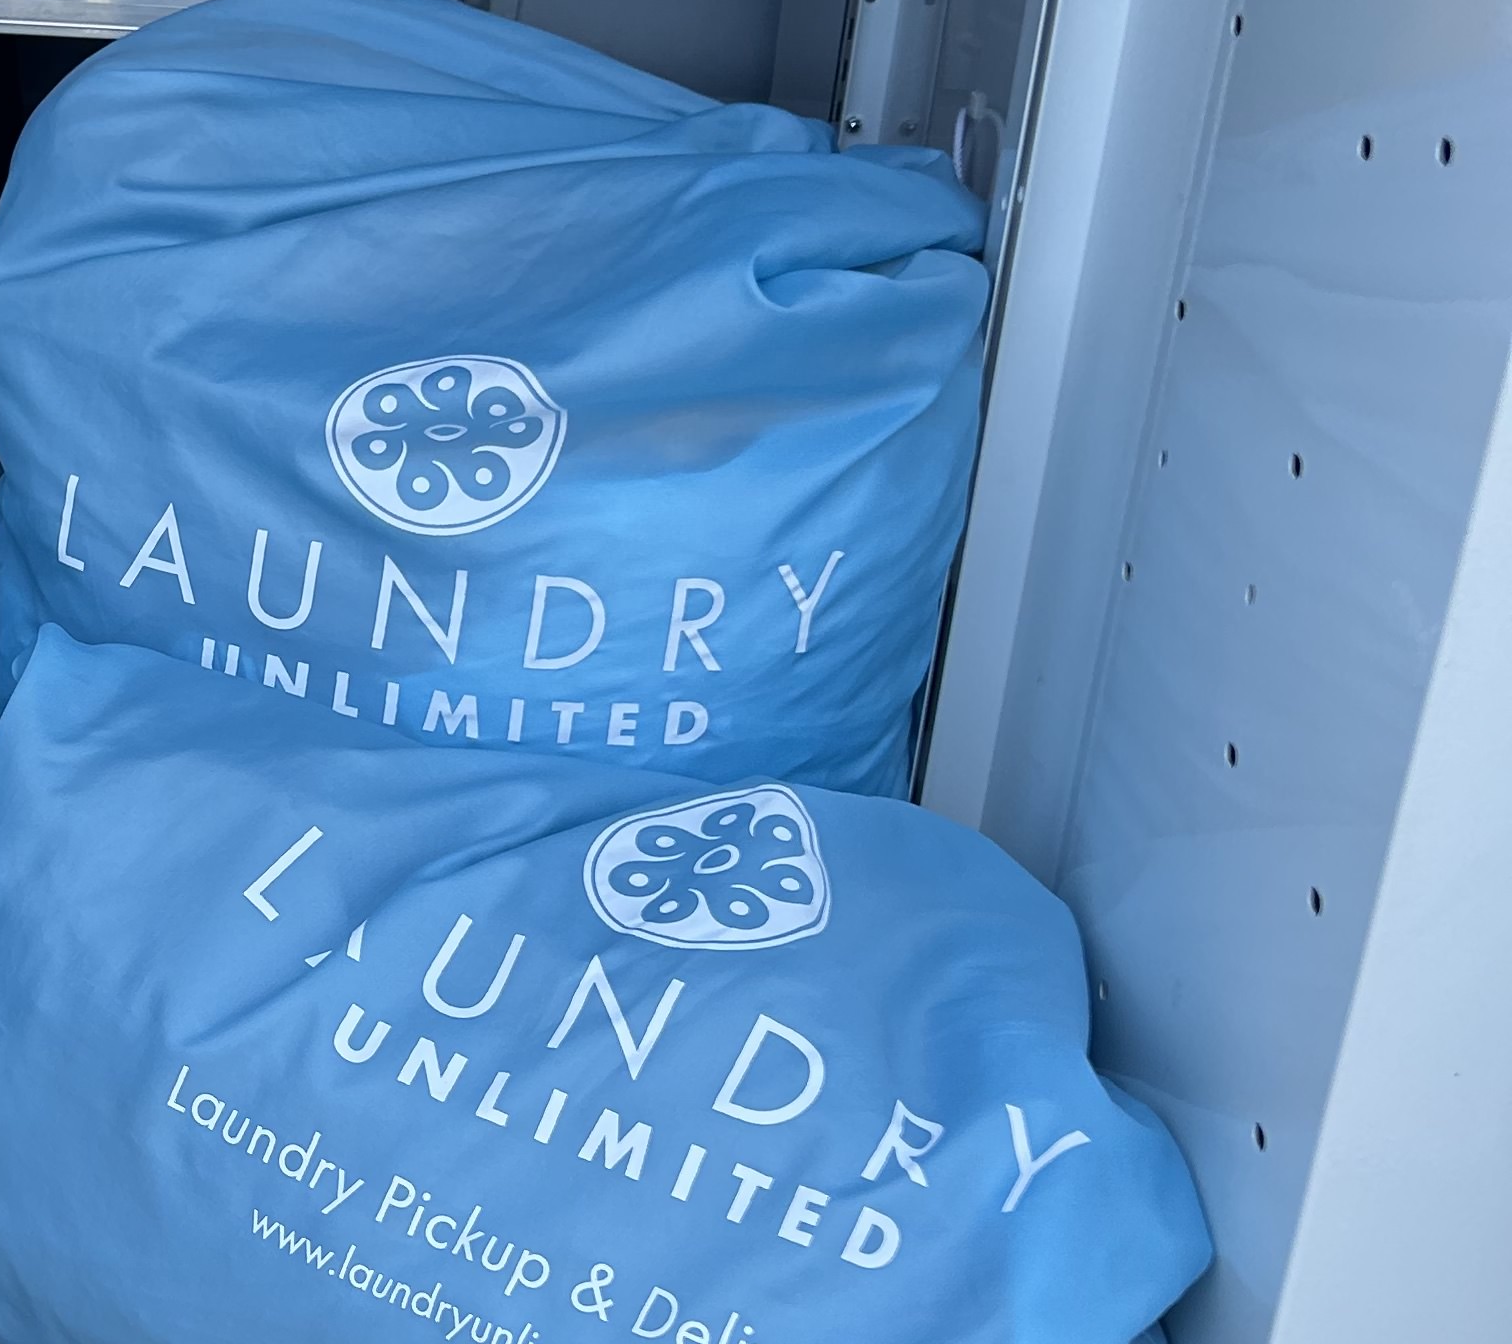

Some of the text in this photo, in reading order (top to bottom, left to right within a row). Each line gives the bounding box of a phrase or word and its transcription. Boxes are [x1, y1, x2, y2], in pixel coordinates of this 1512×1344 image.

[57, 474, 845, 672] LAUNDRY
[201, 638, 708, 746] UNLIMITED
[166, 1063, 364, 1215] Laundry
[375, 1175, 549, 1299] Pickup
[571, 1263, 614, 1324] &
[333, 1003, 900, 1269] UNLIMITED
